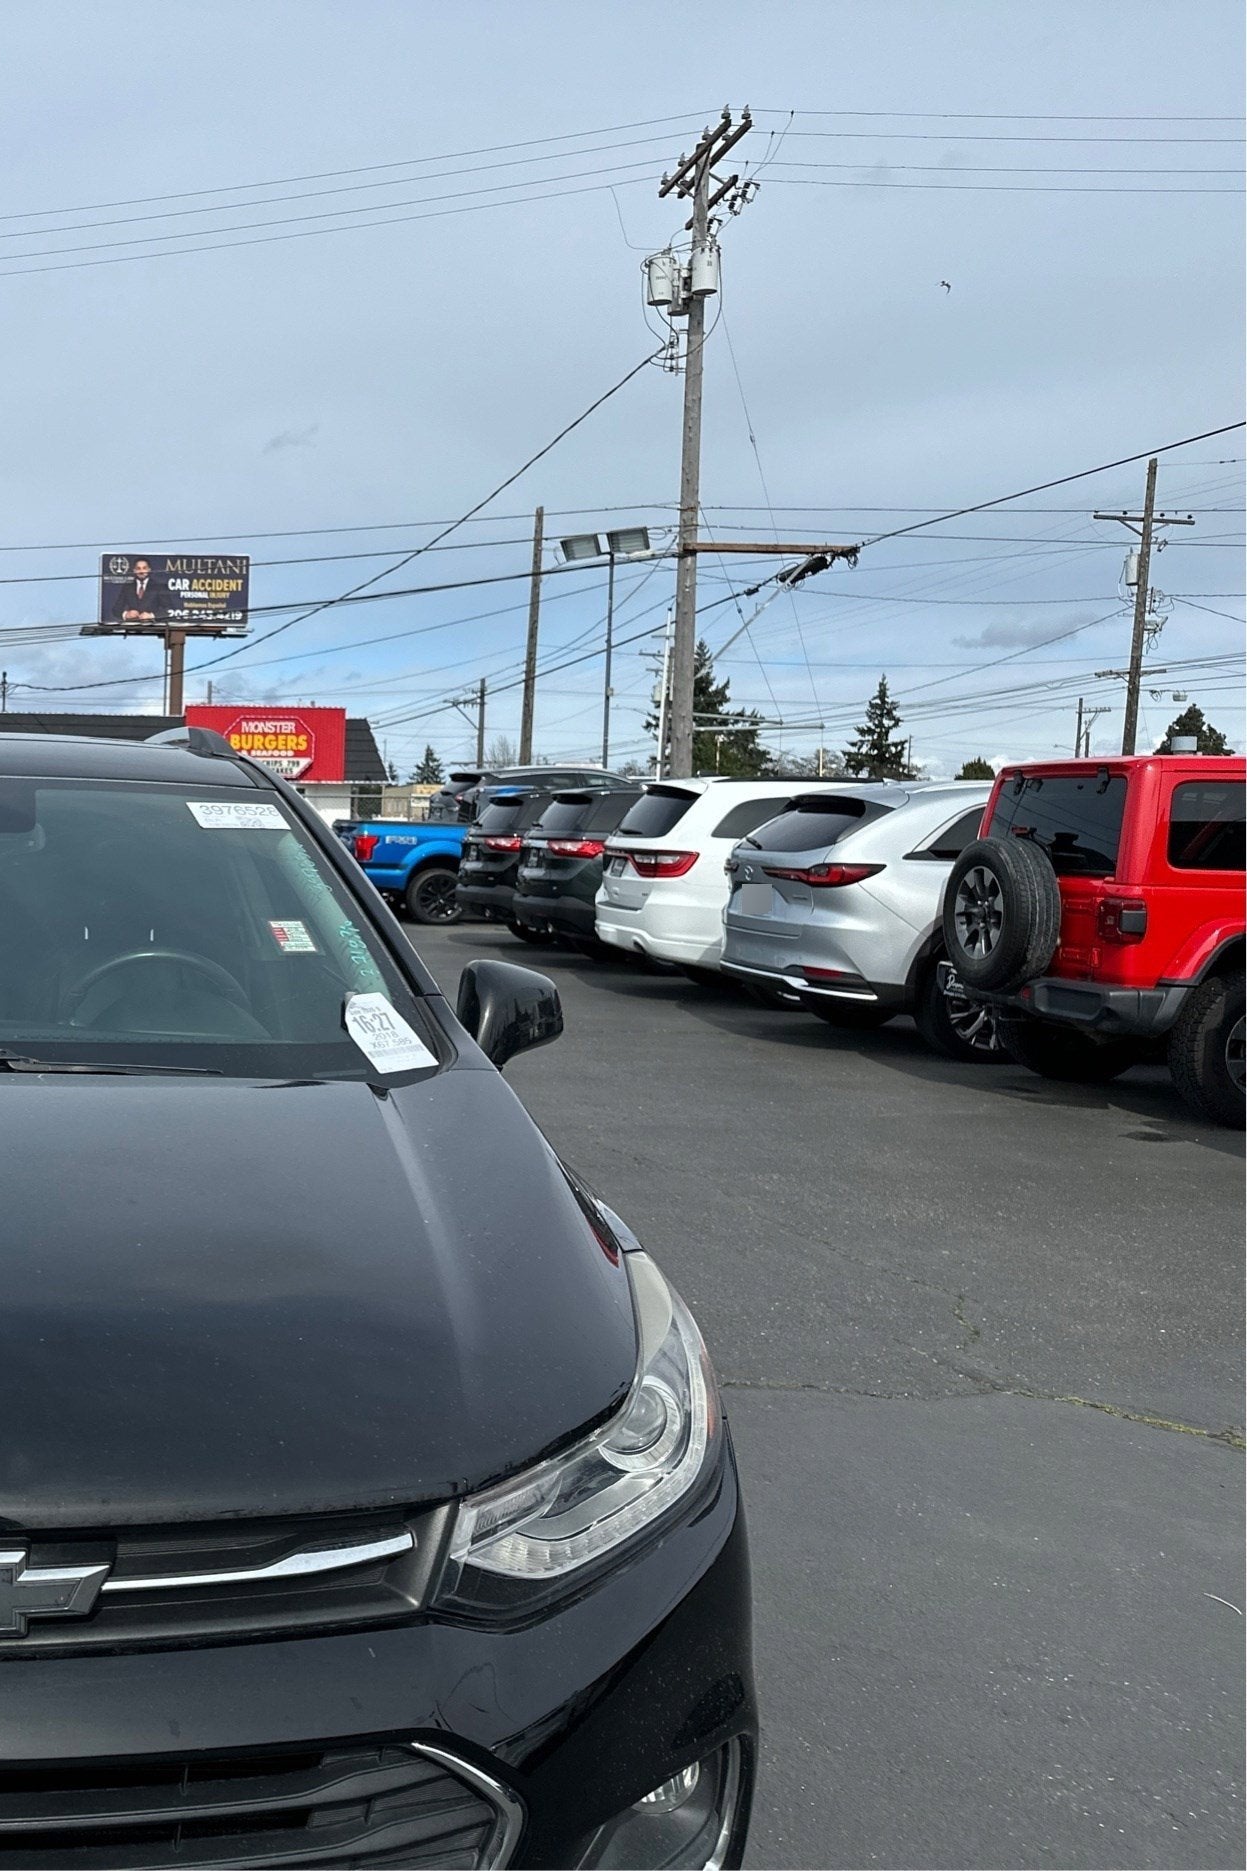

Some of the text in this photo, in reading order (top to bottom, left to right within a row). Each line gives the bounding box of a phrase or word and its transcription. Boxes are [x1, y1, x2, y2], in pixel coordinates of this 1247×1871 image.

[165, 558, 247, 575] MULTANI
[168, 578, 244, 592] CAR ACCIDENT
[180, 591, 209, 599] PERSONAL
[241, 721, 296, 734] MONSTER
[230, 734, 308, 751] BURGERS
[199, 805, 280, 817] 3976528
[352, 1012, 396, 1034] 16:27
[372, 1031, 399, 1041] 2018
